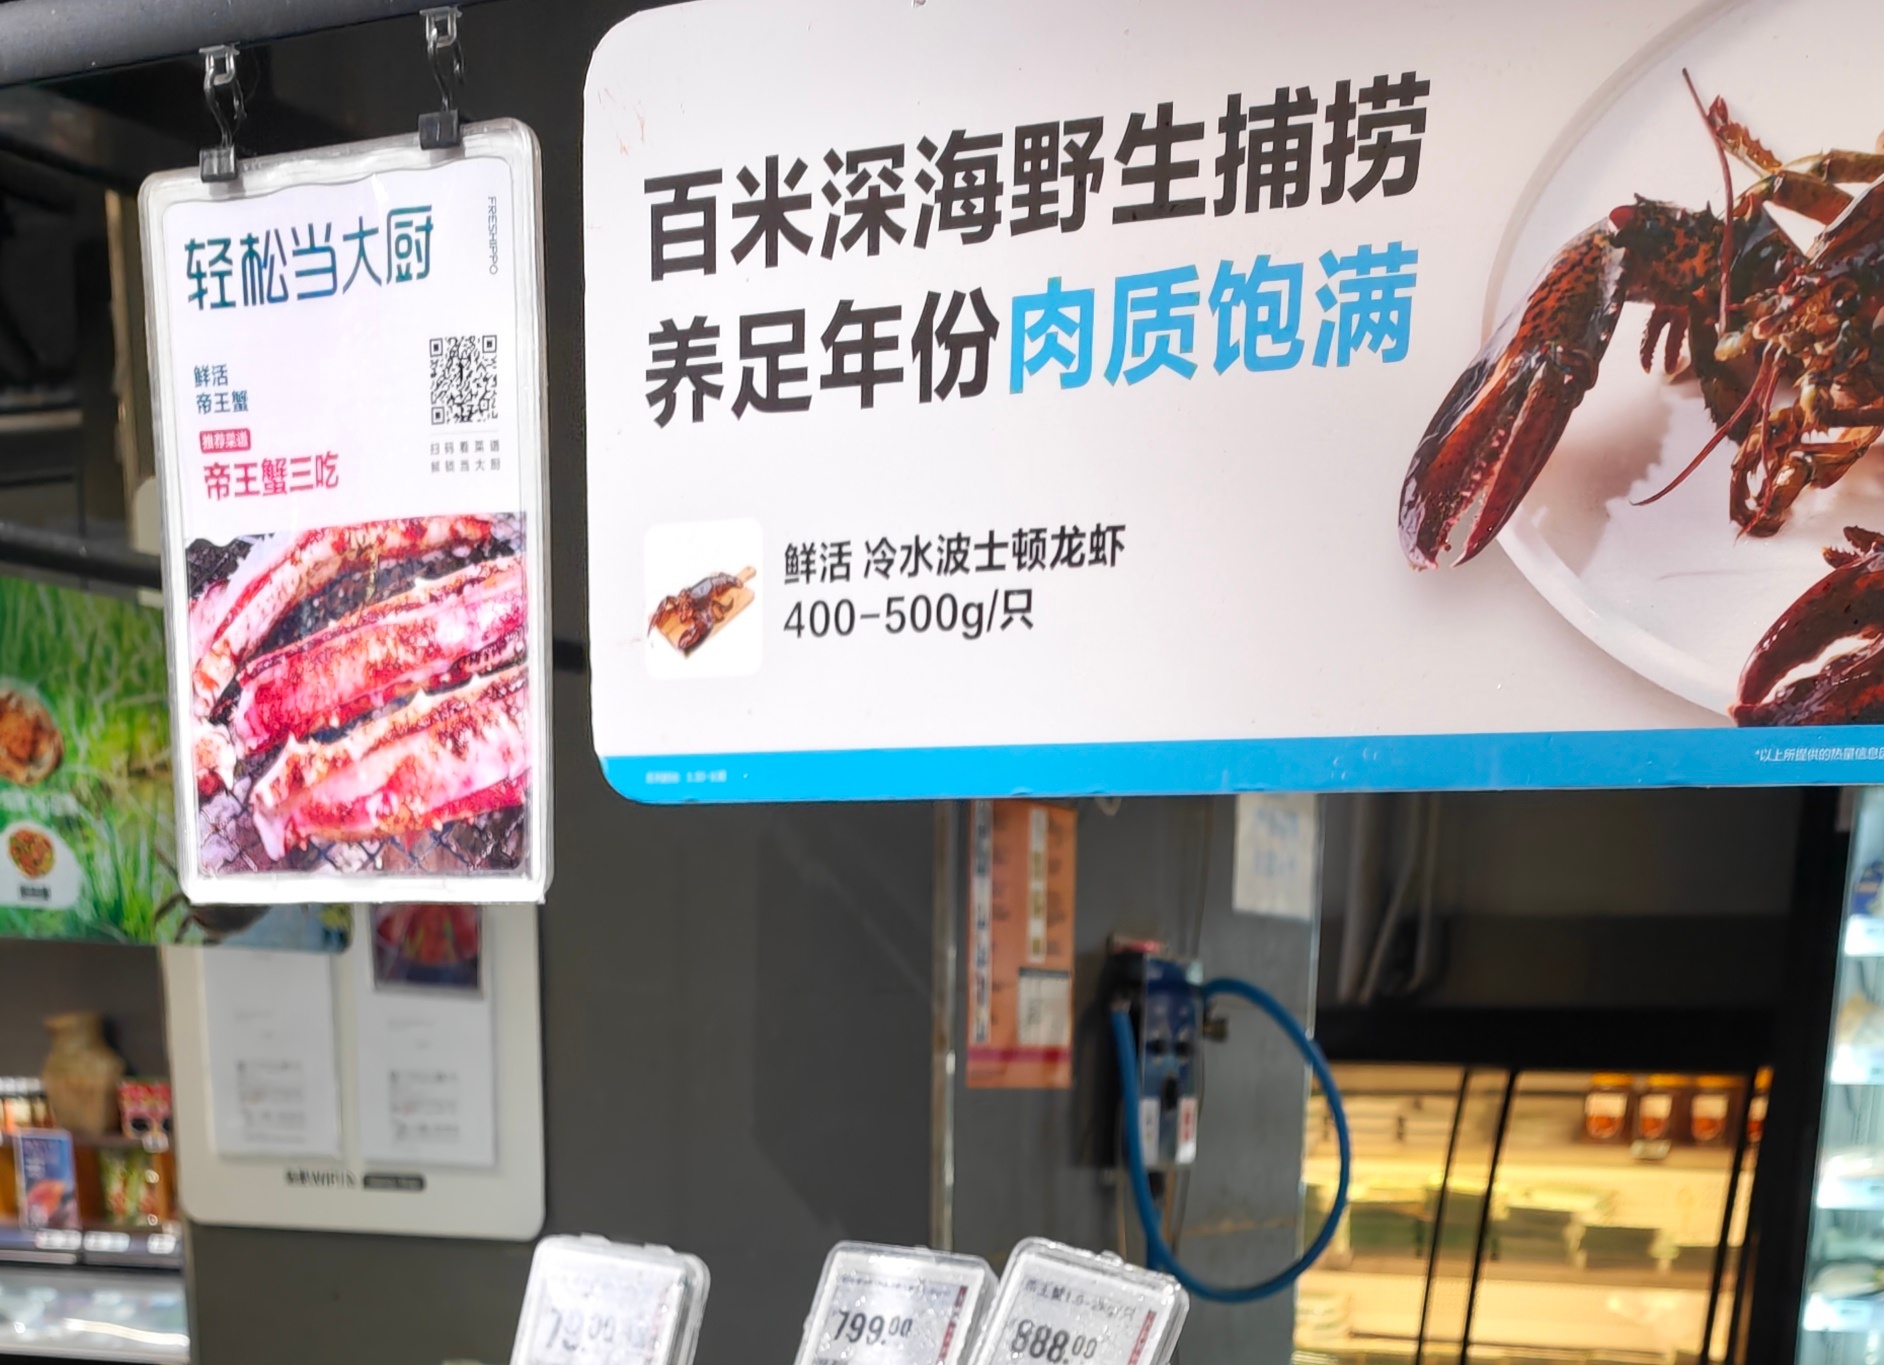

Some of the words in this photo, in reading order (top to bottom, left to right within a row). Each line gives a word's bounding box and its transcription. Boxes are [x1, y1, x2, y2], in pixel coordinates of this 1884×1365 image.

[643, 71, 1431, 281] 百米深海野生捕捞
[184, 204, 434, 311] 轻松当大厨
[488, 196, 499, 275] FRESHIPPO
[644, 241, 1419, 428] 养足年份肉质饱满
[193, 363, 229, 388] 鲜活
[196, 390, 249, 415] 帝王蟹
[203, 451, 339, 501] 帝王蟹三吃
[784, 539, 853, 585] 鲜活
[863, 522, 1127, 580] 冷水波士顿龙虾
[784, 589, 1035, 642] 400-500g/只
[834, 1308, 913, 1346] 799.00
[1011, 1318, 1098, 1365] 888.00
